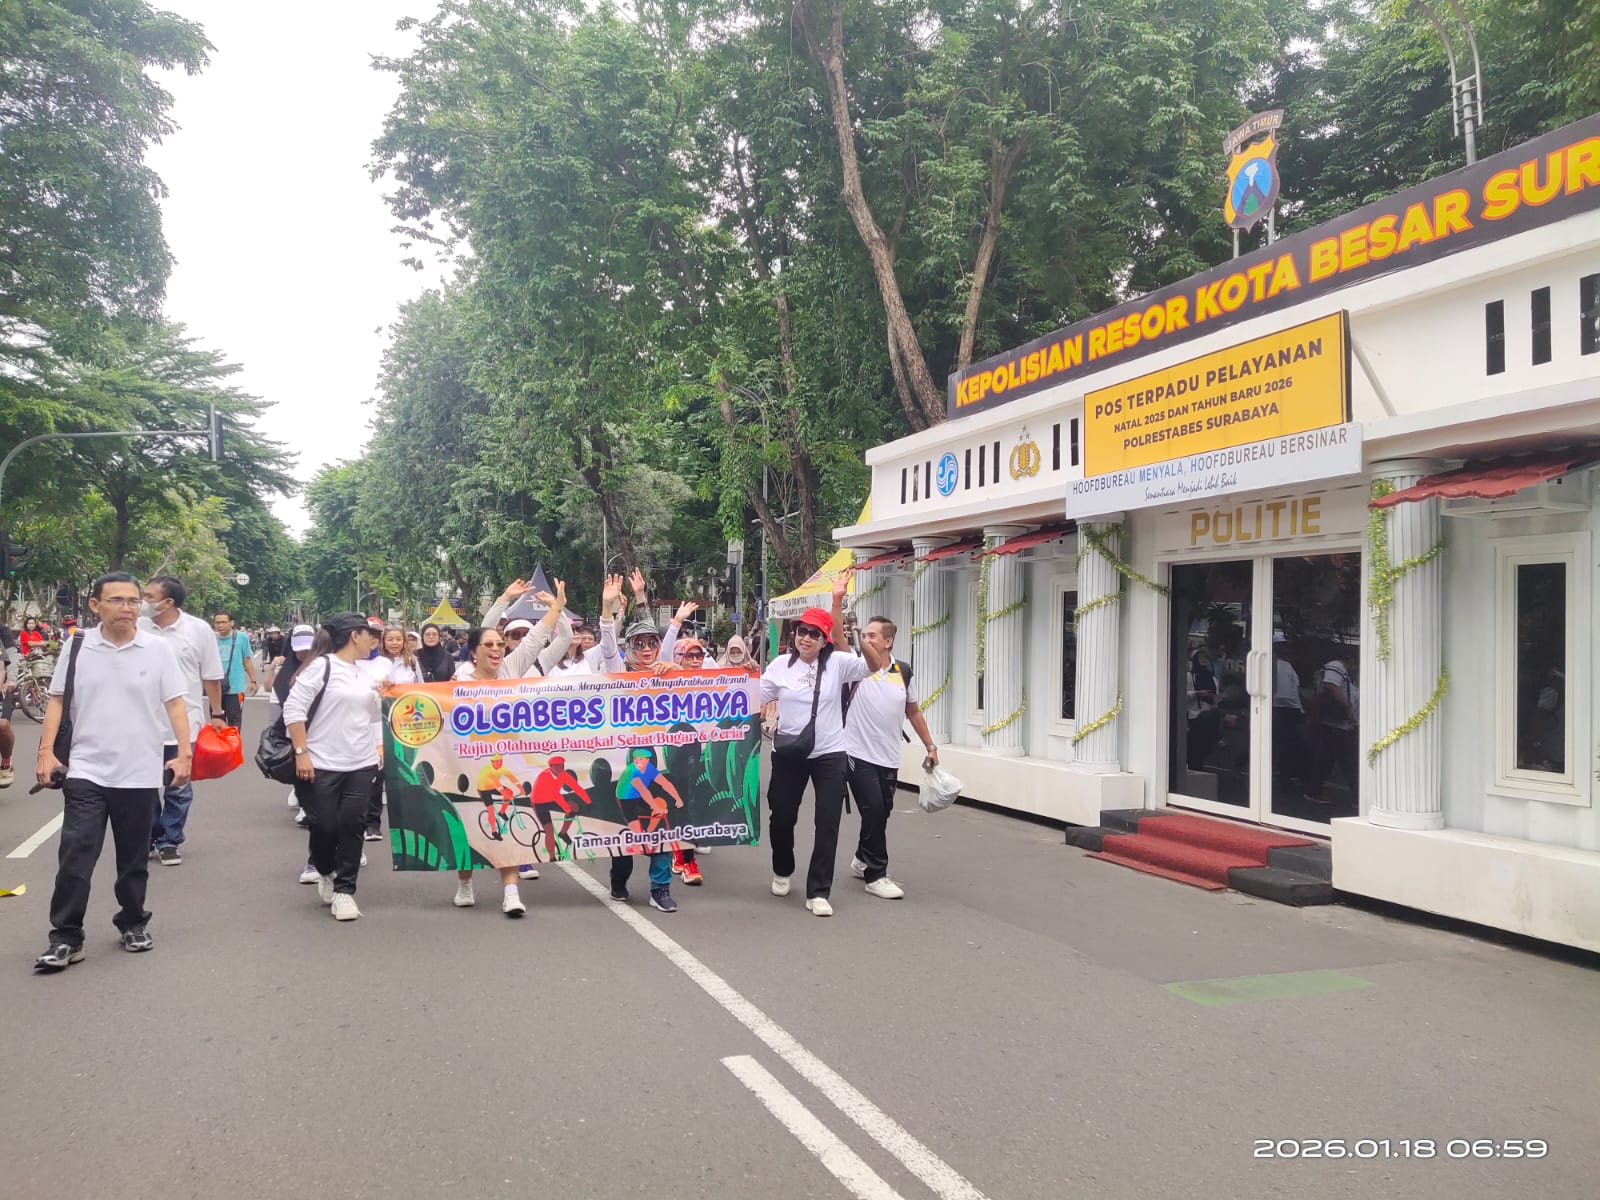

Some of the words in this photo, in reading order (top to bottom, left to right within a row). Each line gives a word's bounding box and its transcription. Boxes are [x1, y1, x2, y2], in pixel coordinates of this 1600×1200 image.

[1227, 127, 1251, 150] JAWA
[1253, 114, 1279, 131] TIMUR
[955, 333, 1083, 408] KEPOLISIAN
[1088, 295, 1189, 358] RESOR
[1195, 253, 1301, 324] KOTA
[1309, 189, 1472, 283] BESAR
[1480, 136, 1600, 221] SUR
[1095, 398, 1122, 419] POS
[1127, 374, 1199, 410] TERPADU
[1206, 337, 1322, 387] PELAYANAN
[1113, 417, 1142, 433] NATAL
[1144, 410, 1165, 425] 2025
[1167, 404, 1189, 419] DAN
[1191, 394, 1227, 413] TAHUN
[1230, 385, 1261, 402] BARU
[1264, 376, 1293, 394] 2026
[1123, 420, 1203, 450] POLRESTABES
[1206, 401, 1279, 430] SURABAYA
[1072, 473, 1136, 495] HOOFDBUREAU
[1139, 461, 1187, 483] MENYALA,
[1190, 441, 1275, 472] HOOFDBUREAU
[1280, 427, 1347, 456] BERSINAR
[1177, 480, 1203, 498] Menjadi
[1220, 472, 1238, 488] Baik
[1190, 496, 1321, 545] POLITIE
[578, 679, 638, 693] Mengenalkan,
[640, 678, 648, 688] &
[650, 676, 714, 690] Mengakrabkan
[452, 696, 604, 733] OLGABERS
[612, 690, 749, 724] IKASMAYA
[496, 739, 557, 753] Olahraga
[561, 736, 613, 750] Pangkal
[617, 733, 654, 747] Sehat
[657, 730, 697, 745] Bugar
[699, 731, 708, 741] &
[574, 835, 621, 848] Taman
[625, 827, 681, 845] Bungkul
[684, 823, 748, 838] Surabaya
